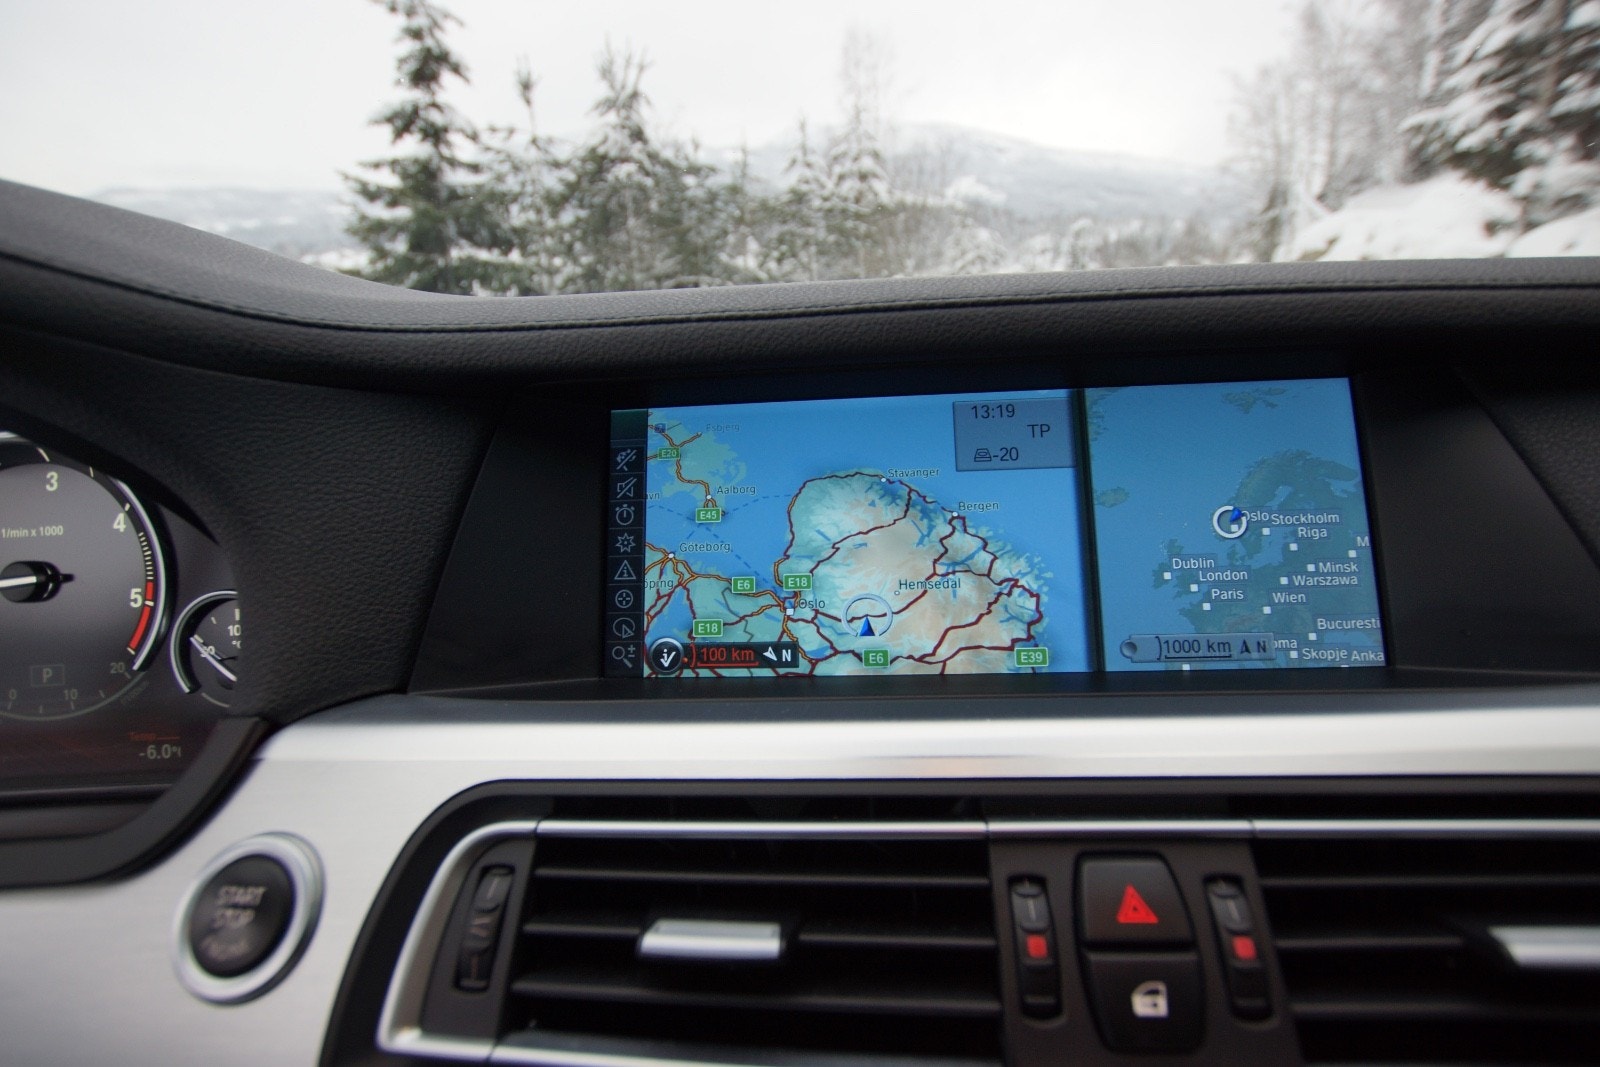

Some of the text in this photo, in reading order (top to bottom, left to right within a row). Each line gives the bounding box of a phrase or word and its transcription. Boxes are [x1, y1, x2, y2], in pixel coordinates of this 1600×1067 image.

[971, 403, 1015, 419] 13:19
[706, 423, 740, 433] Esbjerg
[1027, 423, 1050, 438] TP
[661, 450, 677, 458] E20
[992, 447, 1019, 462] -20
[888, 468, 940, 480] Stavanger
[45, 471, 59, 492] 3
[717, 485, 756, 496] Aalborg
[958, 501, 999, 514] Bergen
[700, 511, 717, 520] E45
[1271, 512, 1340, 525] Stockholm
[113, 513, 126, 533] 4
[2, 525, 64, 539] 1/min x 1000
[1298, 526, 1328, 540] Riga
[679, 542, 731, 553] Göteborg
[1172, 557, 1215, 570] Dublin
[1318, 561, 1359, 573] Minsk
[1199, 569, 1248, 582] London
[1292, 574, 1358, 587] Warszawa
[737, 579, 751, 590] E6
[788, 577, 808, 588] E18
[898, 578, 961, 590] Hemsedal
[130, 588, 143, 608] 5
[1211, 588, 1244, 601] Paris
[1272, 591, 1307, 604] Wien
[798, 598, 826, 610] Oslo
[697, 623, 718, 634] E18
[1317, 617, 1382, 631] Bucuresti
[1163, 638, 1267, 655] 1000 km N
[701, 647, 792, 662] 100 km N
[868, 653, 884, 664] E6
[1020, 652, 1043, 663] E39
[1302, 647, 1348, 662] Skopje
[1351, 649, 1384, 662] Anka
[110, 662, 125, 674] 20
[42, 669, 53, 684] P
[8, 688, 17, 700] 0
[63, 688, 78, 700] 10
